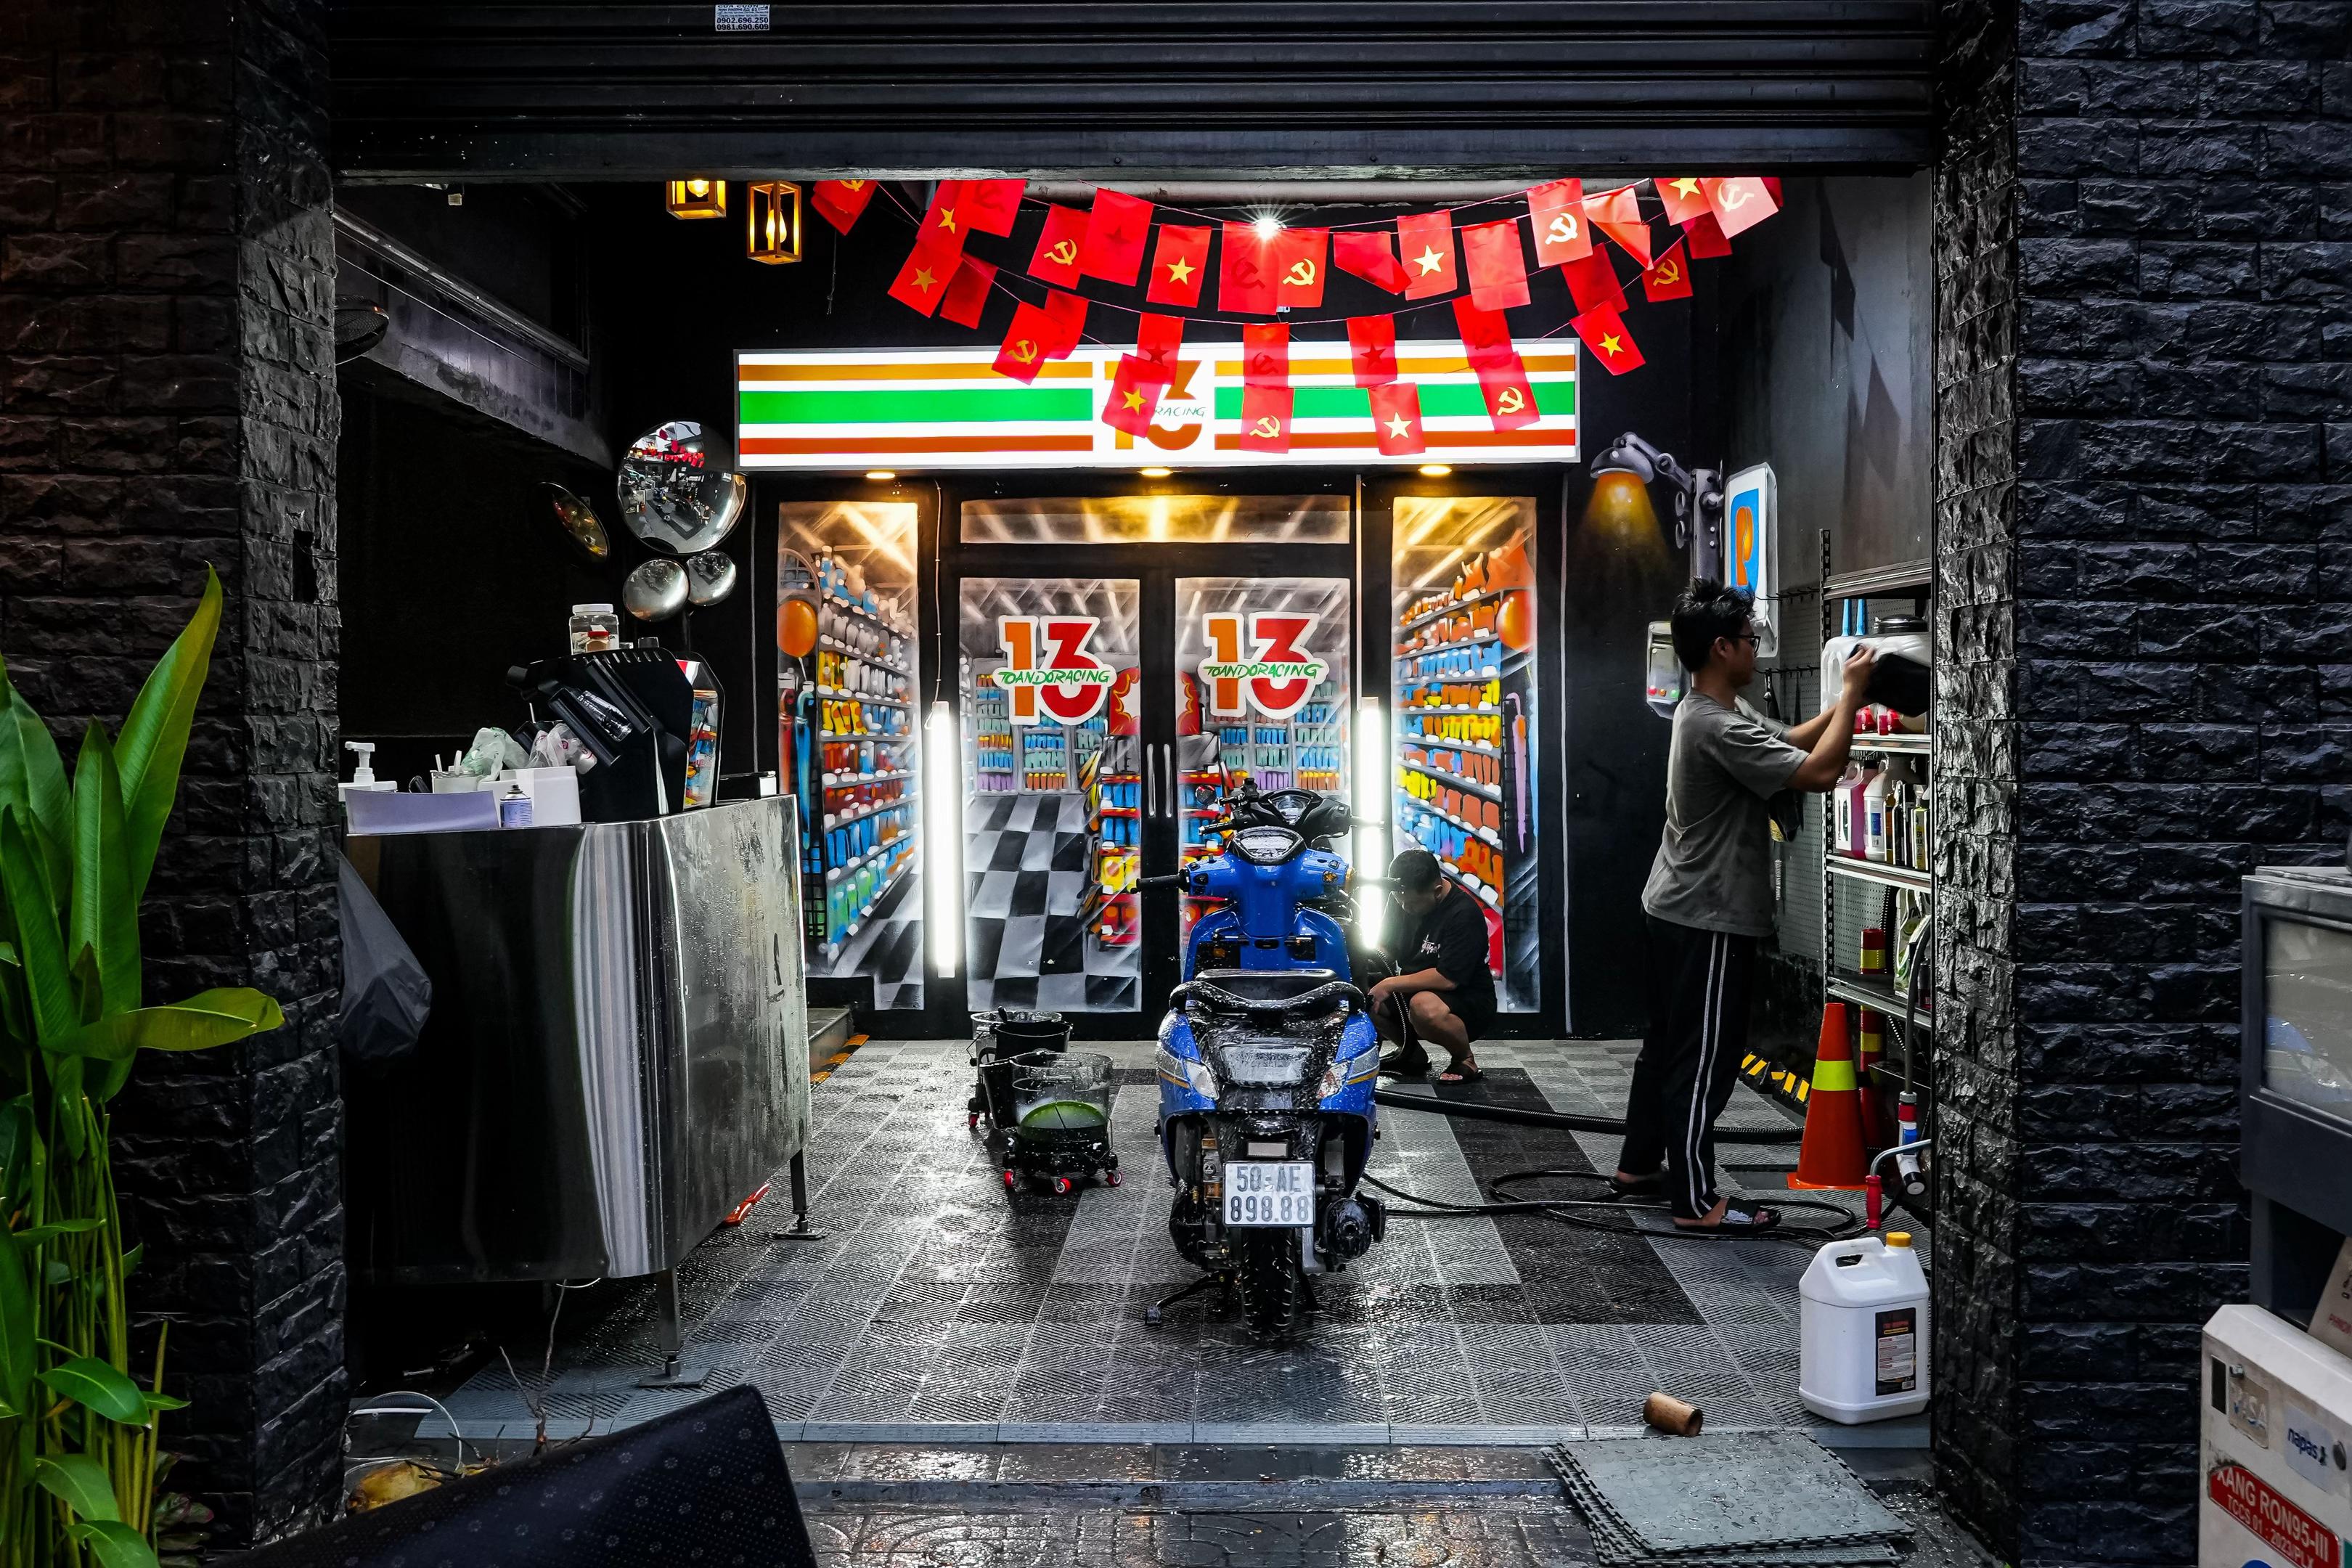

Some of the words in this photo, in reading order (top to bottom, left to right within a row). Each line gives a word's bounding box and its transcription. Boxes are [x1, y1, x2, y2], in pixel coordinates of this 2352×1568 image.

[997, 669, 1111, 685] TOANDORACING
[1005, 621, 1102, 718] 13
[1202, 662, 1324, 679] TOANDORACING
[1208, 618, 1310, 710] 13
[1230, 1196, 1308, 1222] 898.88
[2227, 1494, 2251, 1525] TCCS
